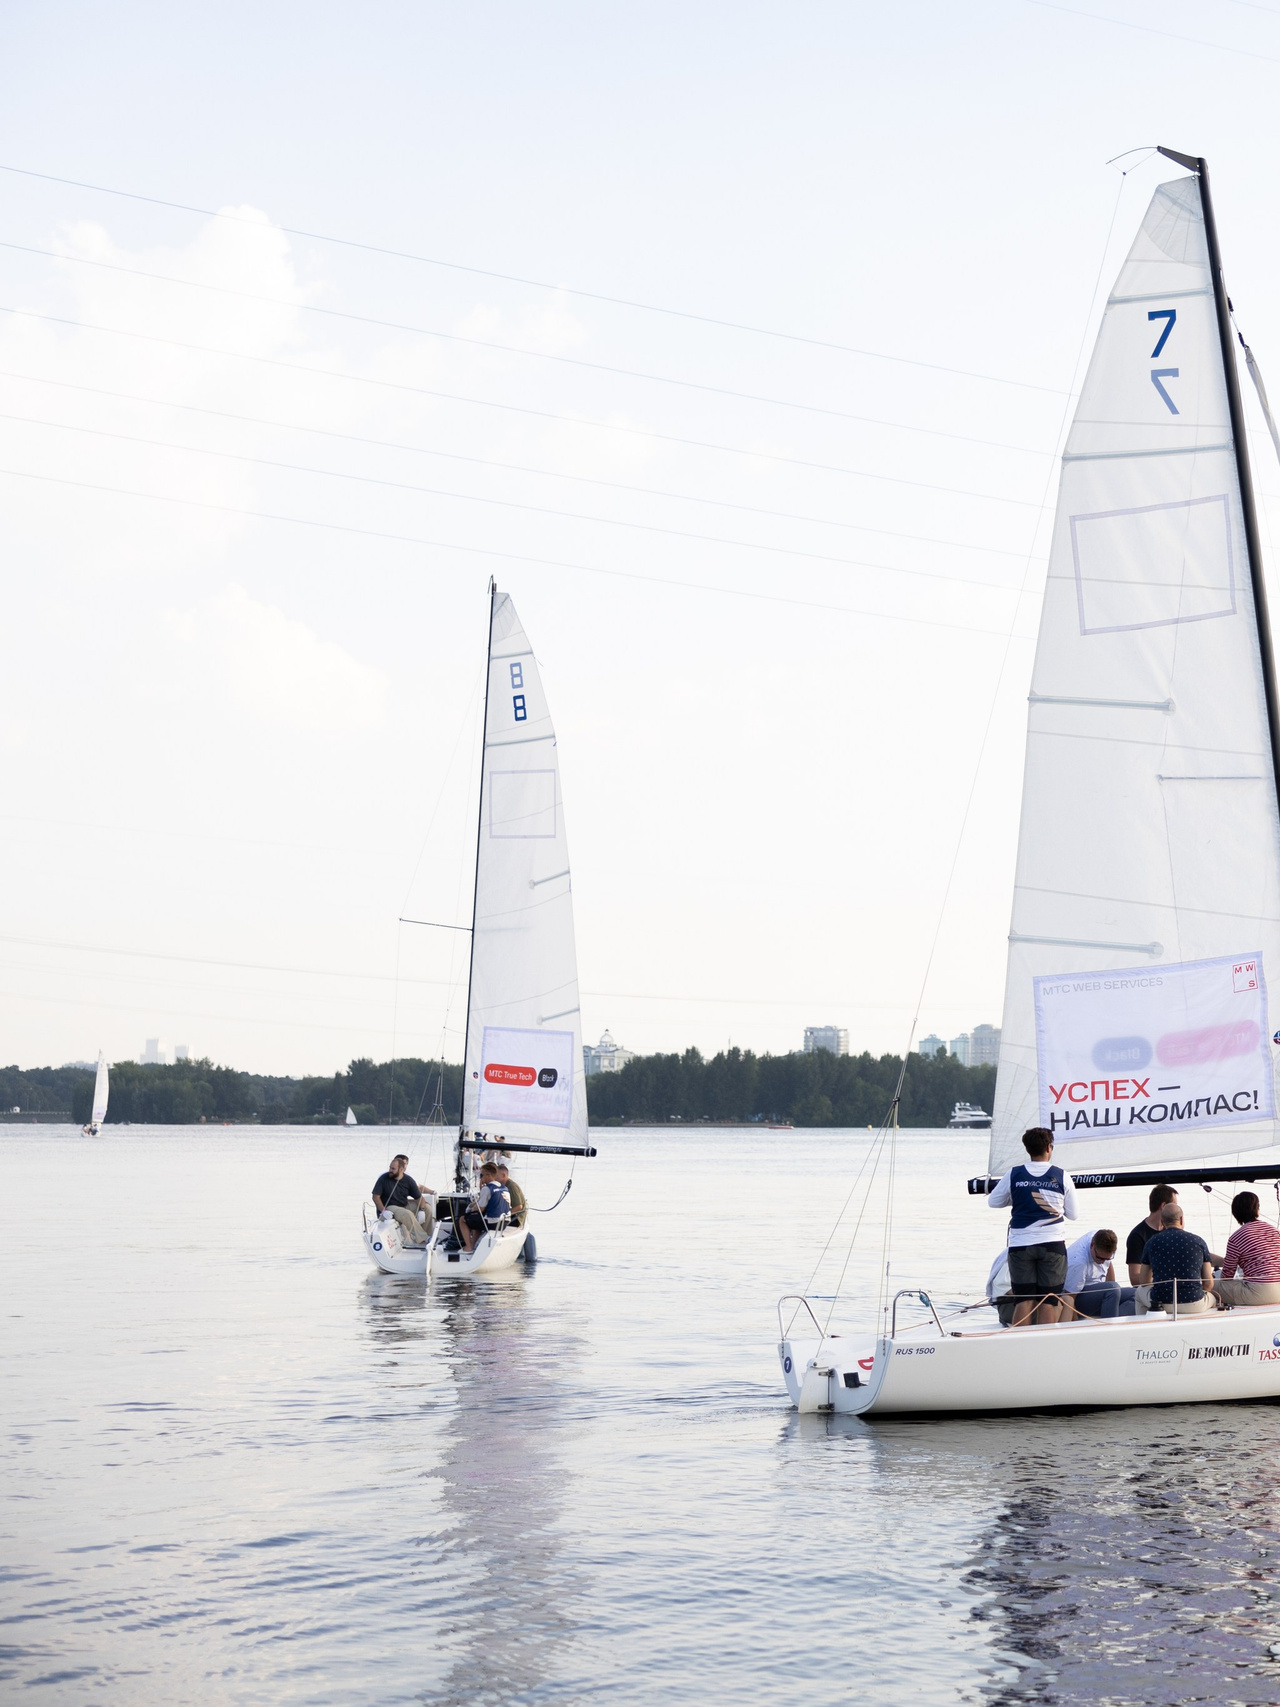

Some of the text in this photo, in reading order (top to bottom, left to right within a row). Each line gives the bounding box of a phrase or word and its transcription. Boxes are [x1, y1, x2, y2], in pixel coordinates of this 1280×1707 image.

[1147, 308, 1177, 359] 7
[510, 661, 524, 689] 8
[512, 694, 527, 721] 8
[1072, 981, 1101, 992] WEB
[1103, 976, 1164, 990] SERVICES
[503, 1071, 518, 1080] True
[518, 1073, 533, 1081] Tech
[541, 1074, 555, 1083] Black
[1049, 1077, 1151, 1105] УСПЕХ
[1050, 1090, 1260, 1132] НАШ КОМПАС!
[1015, 1180, 1060, 1189] PROYACHTING
[1187, 1343, 1250, 1360] ВЕДОМОСТИ
